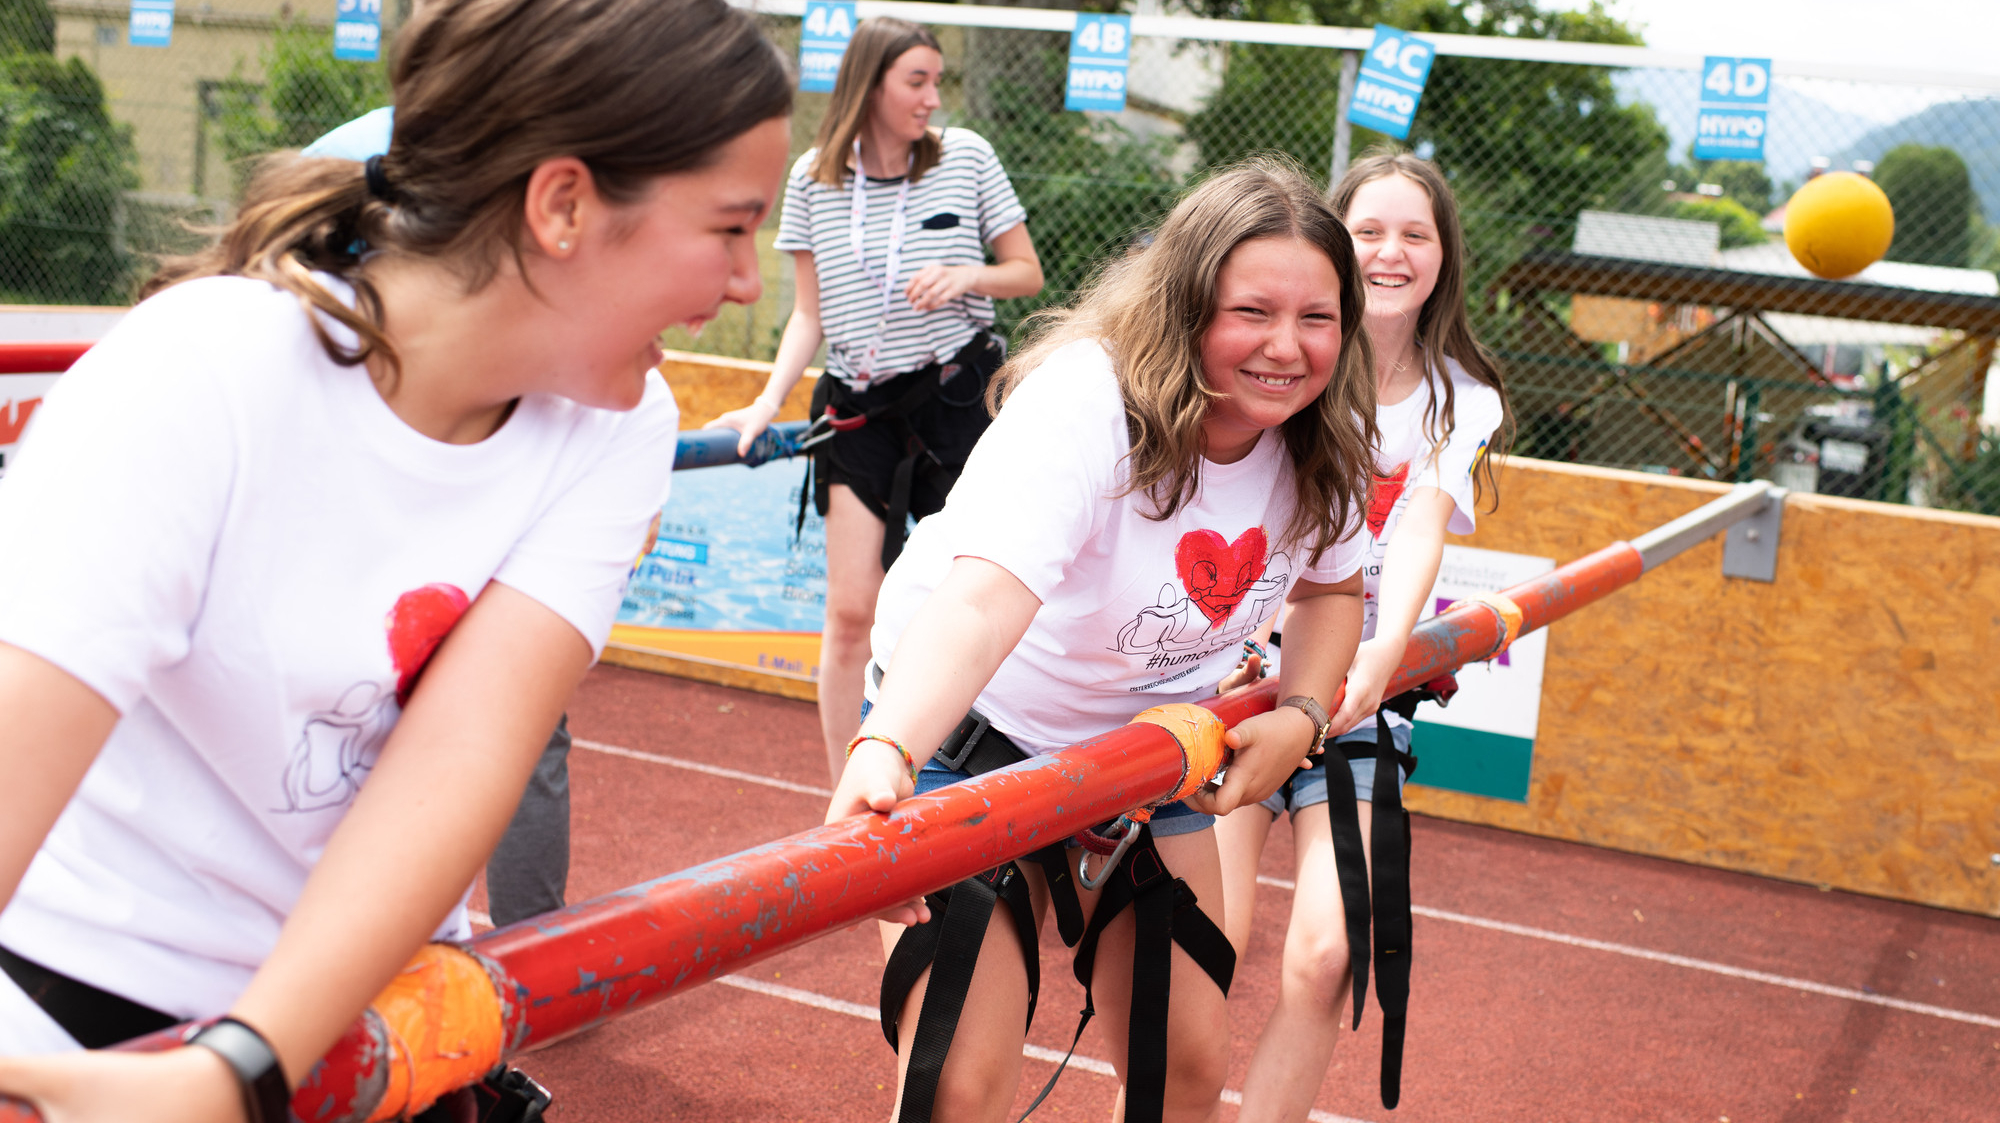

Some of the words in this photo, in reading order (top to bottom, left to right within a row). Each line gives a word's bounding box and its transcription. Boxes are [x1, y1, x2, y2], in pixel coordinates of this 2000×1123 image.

[805, 6, 851, 37] 4A
[1077, 21, 1126, 54] 4B
[801, 51, 841, 71] HYP
[1372, 36, 1428, 78] 4C
[1069, 68, 1125, 90] HYPO
[1705, 62, 1767, 97] 4D
[1355, 80, 1416, 115] HYPO
[1700, 113, 1764, 138] HYPO
[784, 557, 826, 581] Sola
[781, 583, 826, 604] Biom
